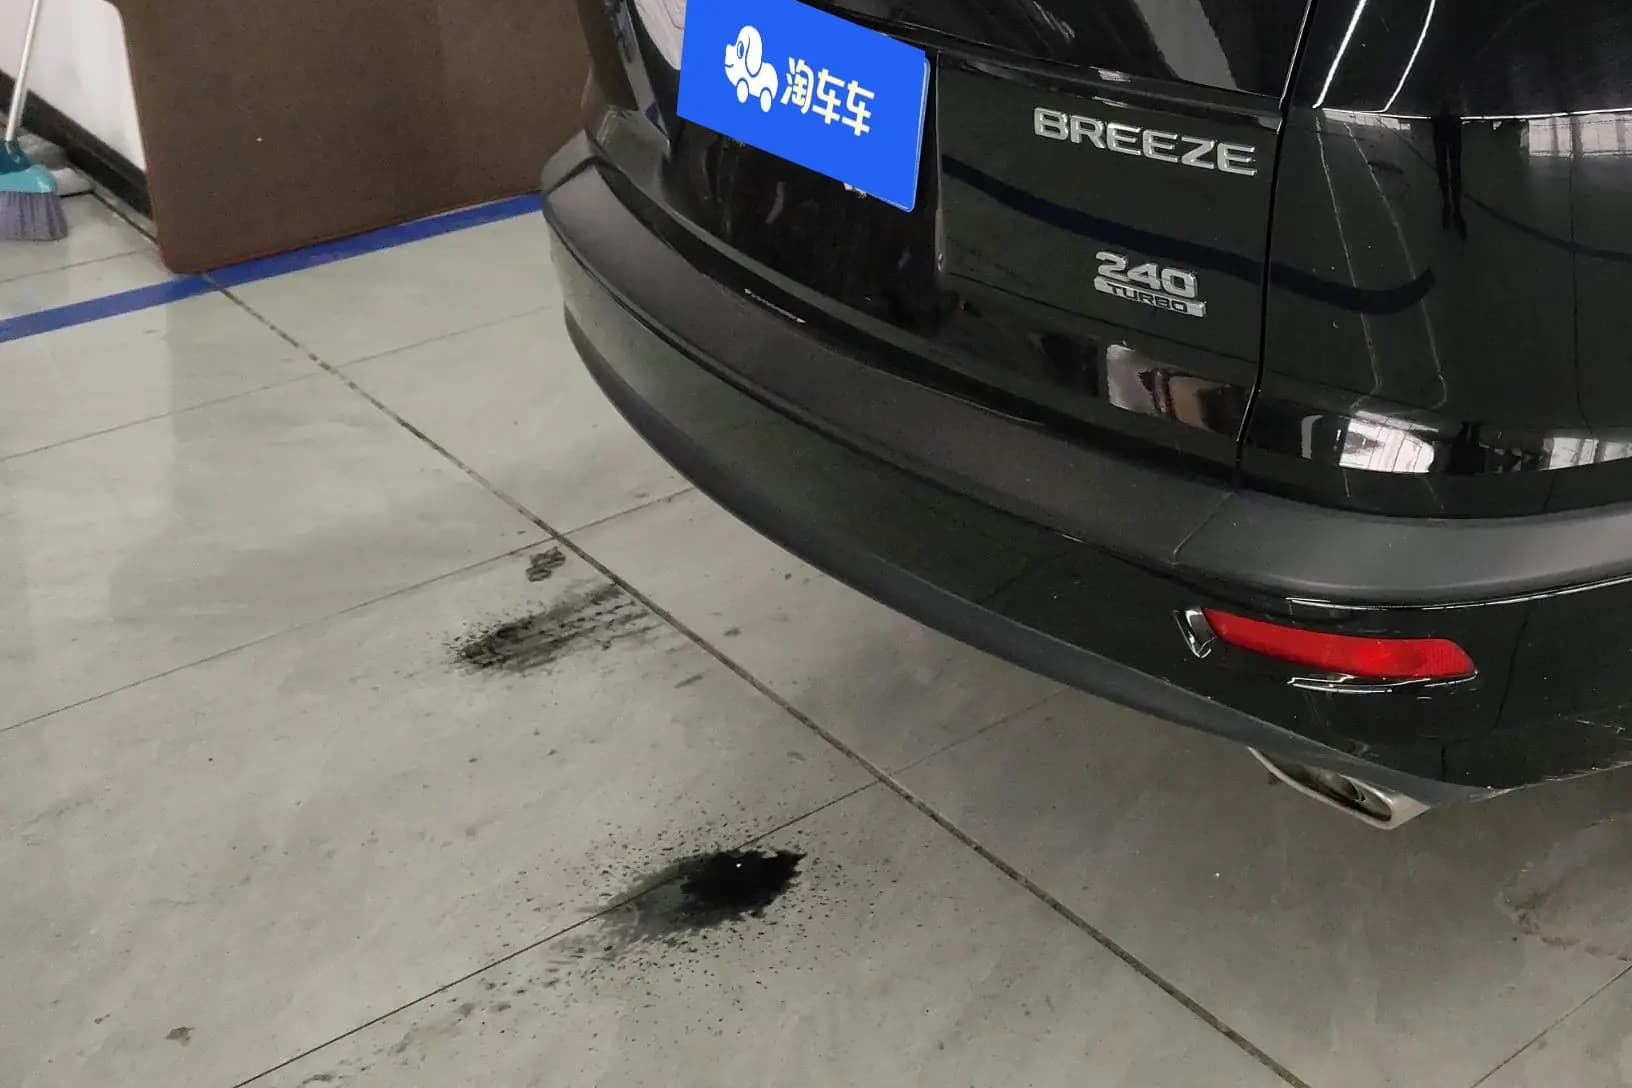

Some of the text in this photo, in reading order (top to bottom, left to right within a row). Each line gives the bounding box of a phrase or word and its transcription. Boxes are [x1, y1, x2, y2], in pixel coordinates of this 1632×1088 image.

[1034, 107, 1257, 176] BREEZE
[1096, 251, 1197, 298] 240
[1106, 282, 1188, 313] TURBO
